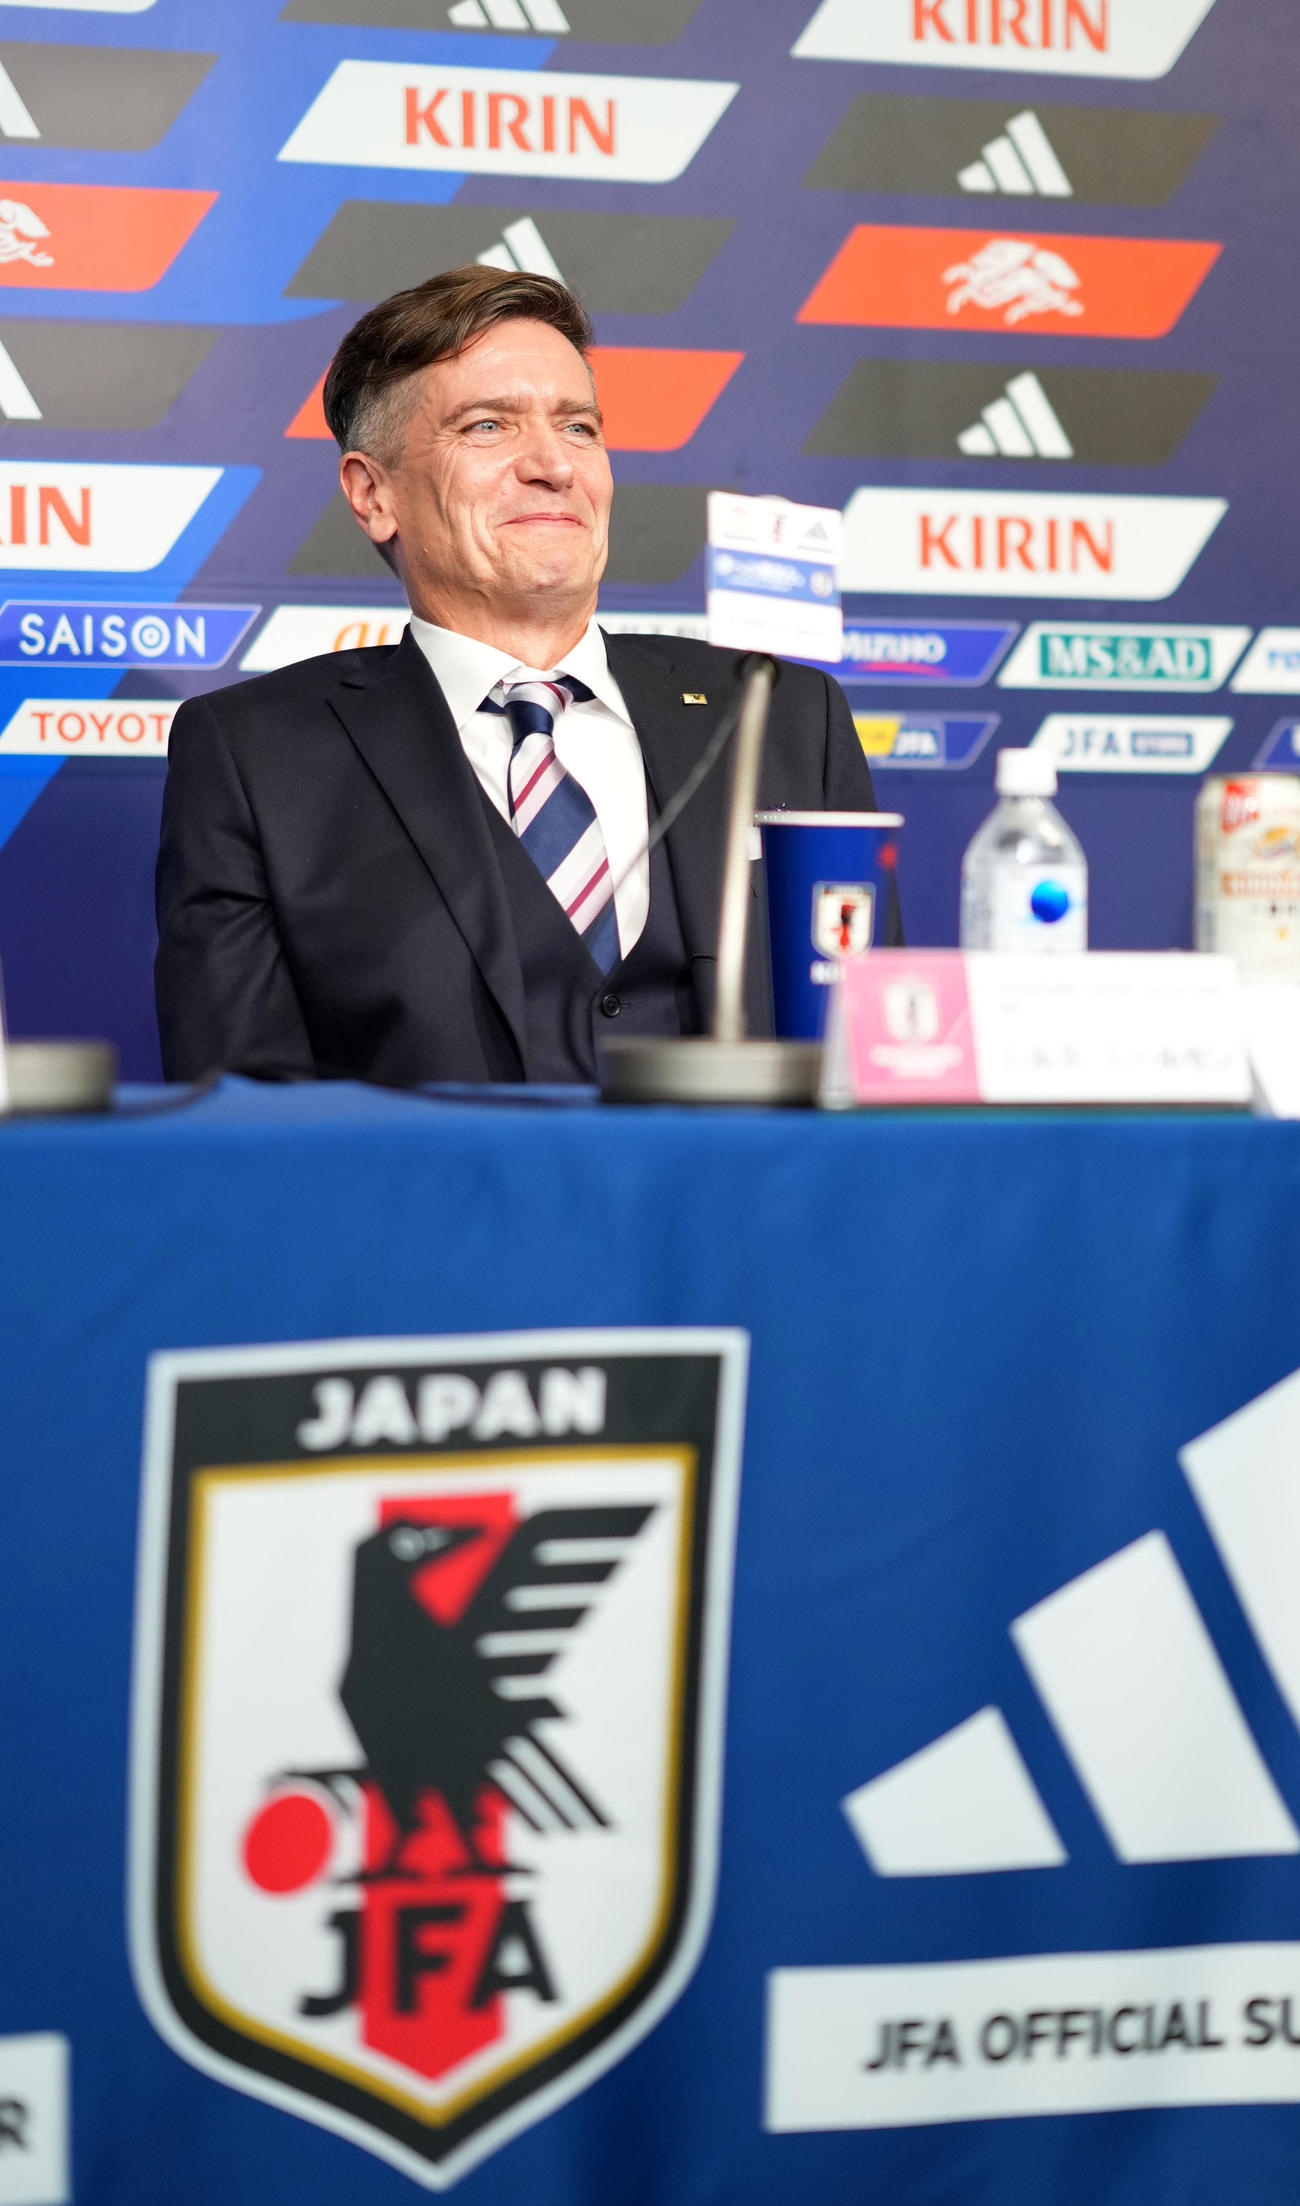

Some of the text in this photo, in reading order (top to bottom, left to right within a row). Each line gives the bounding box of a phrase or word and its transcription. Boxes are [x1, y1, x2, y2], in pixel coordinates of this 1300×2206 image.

[912, 0, 1107, 53] KIRIN
[403, 86, 618, 156] KIRIN
[0, 484, 91, 547] IN
[919, 513, 1115, 575] KIRIN
[19, 613, 206, 658] SAISON
[1048, 635, 1208, 679] MS&AD
[31, 712, 170, 743] TOYOT
[1062, 730, 1120, 757] JFA
[297, 1366, 606, 1450] JAPAN
[298, 1897, 561, 2018] JFA
[865, 2020, 962, 2074] JFA
[980, 1998, 1223, 2065] OFFICIAL
